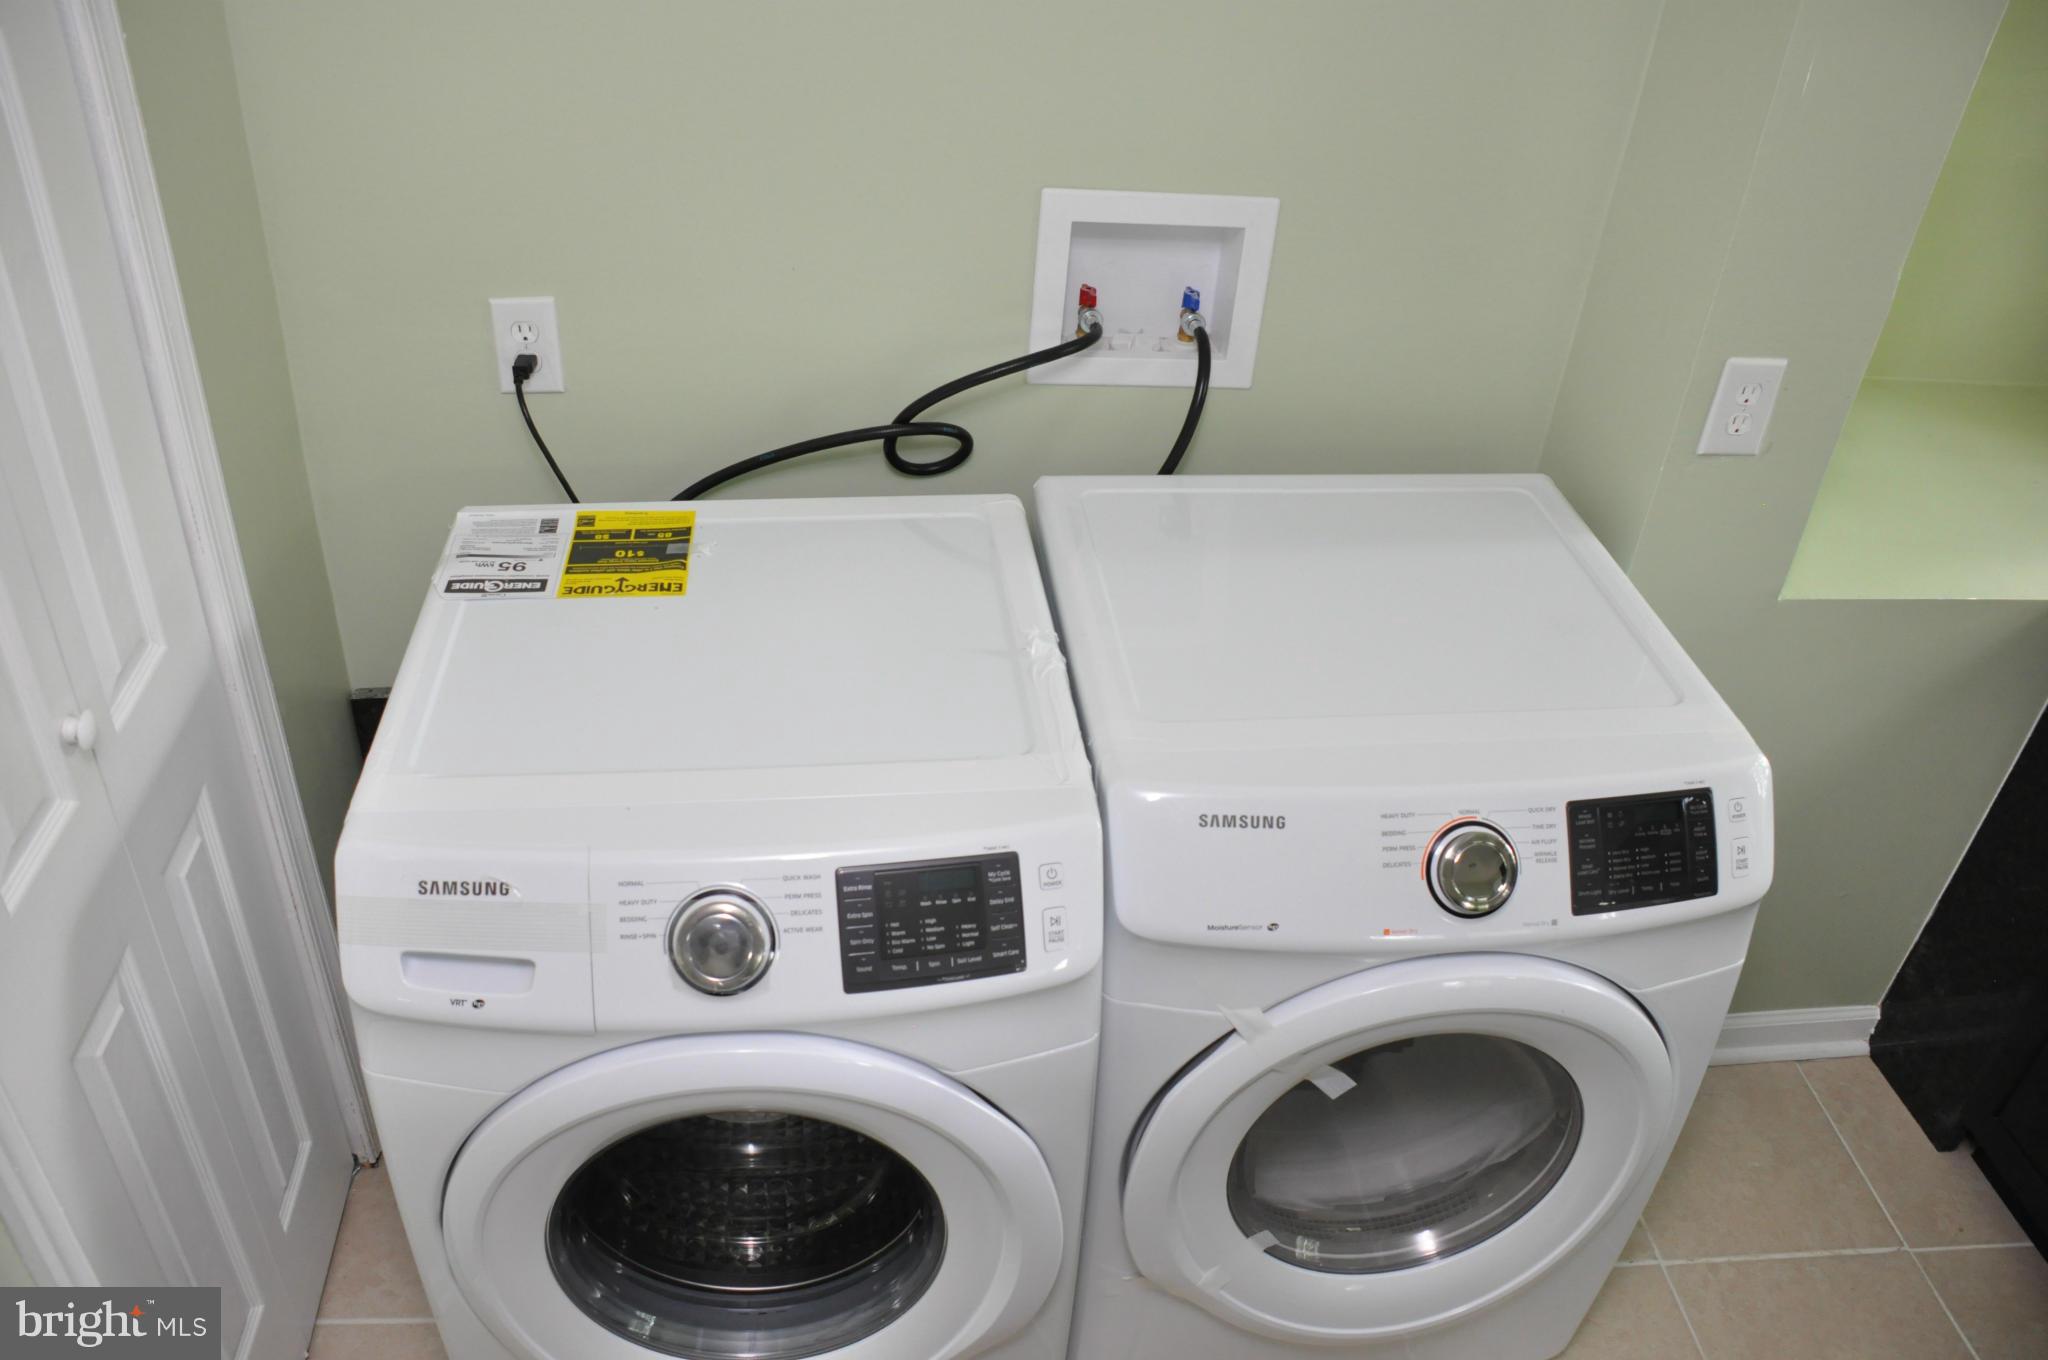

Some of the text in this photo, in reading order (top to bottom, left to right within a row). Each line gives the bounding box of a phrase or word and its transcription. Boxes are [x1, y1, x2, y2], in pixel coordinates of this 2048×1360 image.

[497, 561, 527, 572] 95
[561, 580, 683, 595] ENERGYGUIDE
[1198, 814, 1287, 829] SAMSUNG
[418, 879, 510, 897] SAMSUNG
